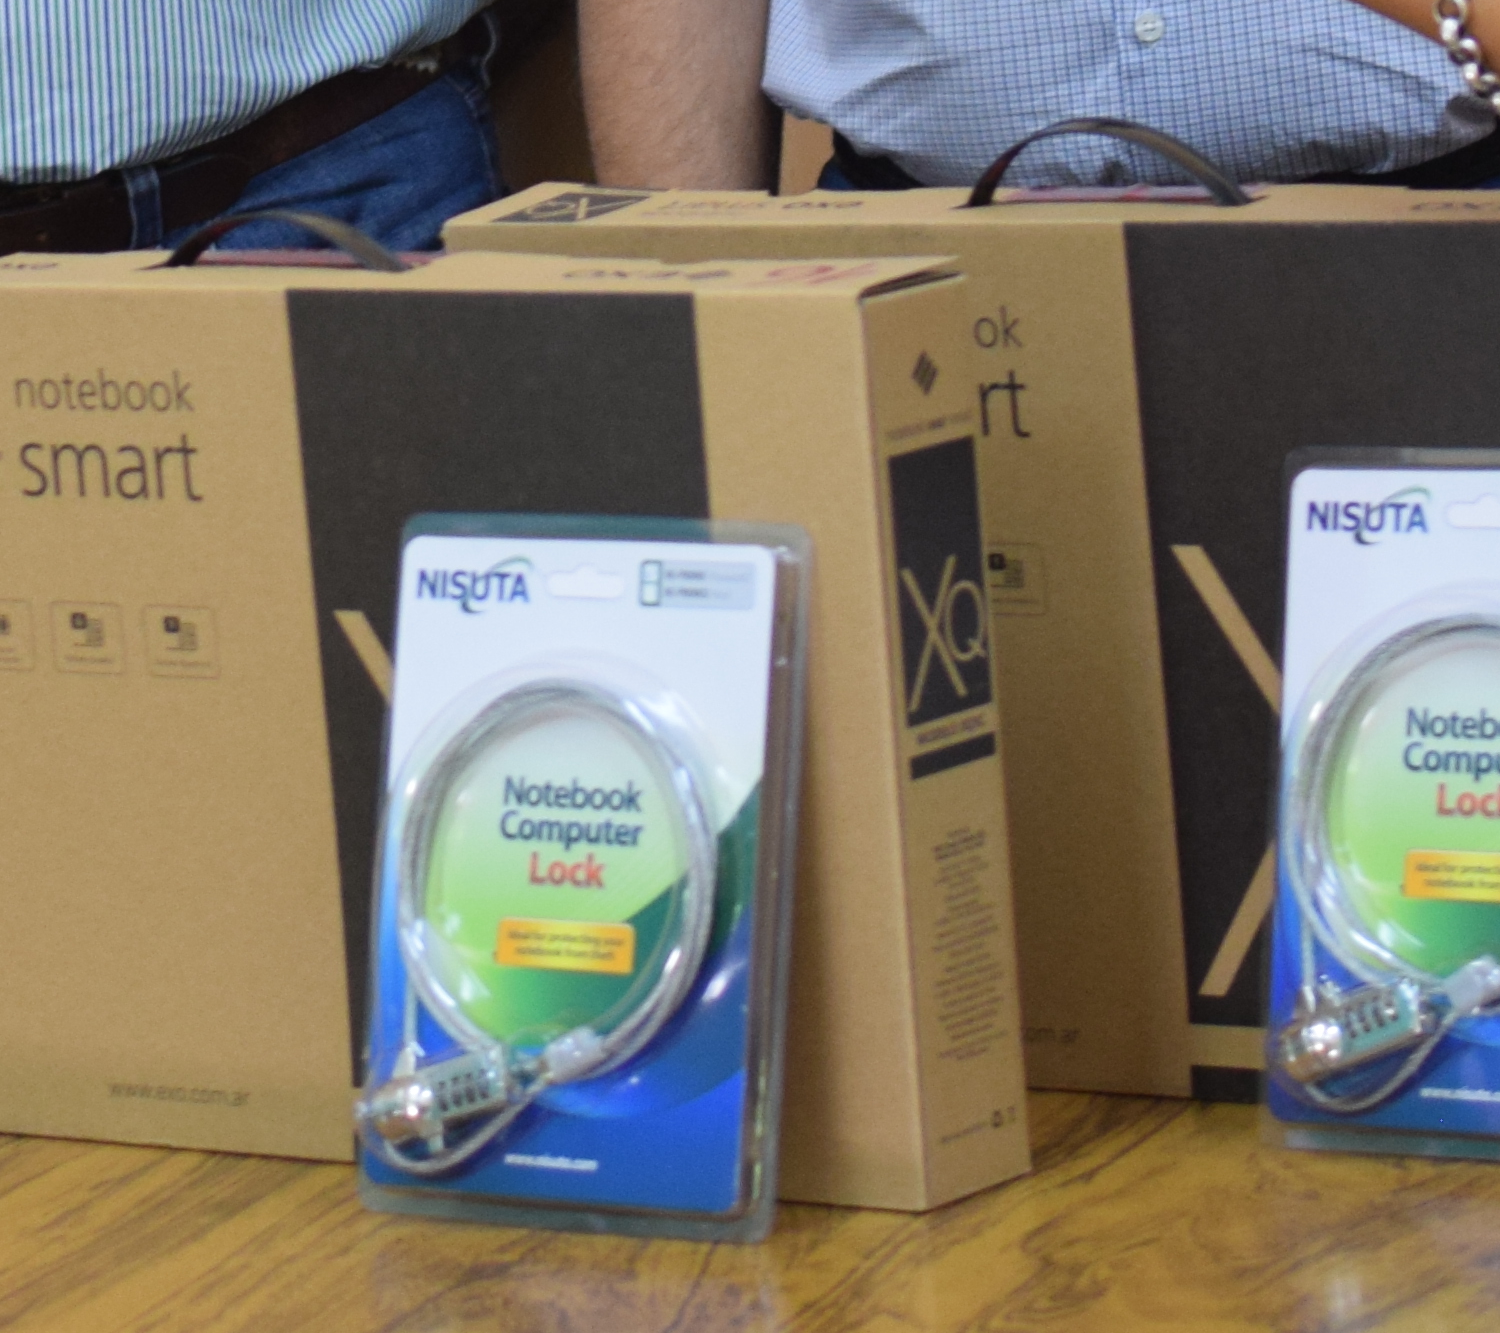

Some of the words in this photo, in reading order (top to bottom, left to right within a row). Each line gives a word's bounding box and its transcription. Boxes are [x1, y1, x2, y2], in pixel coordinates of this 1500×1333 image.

[14, 369, 195, 413] notebook
[19, 435, 203, 502] smart
[1305, 497, 1429, 545] NISUTA
[416, 565, 531, 613] NISUTA
[502, 776, 642, 814] Notebook
[499, 809, 643, 852] Computer
[527, 852, 606, 889] Lock
